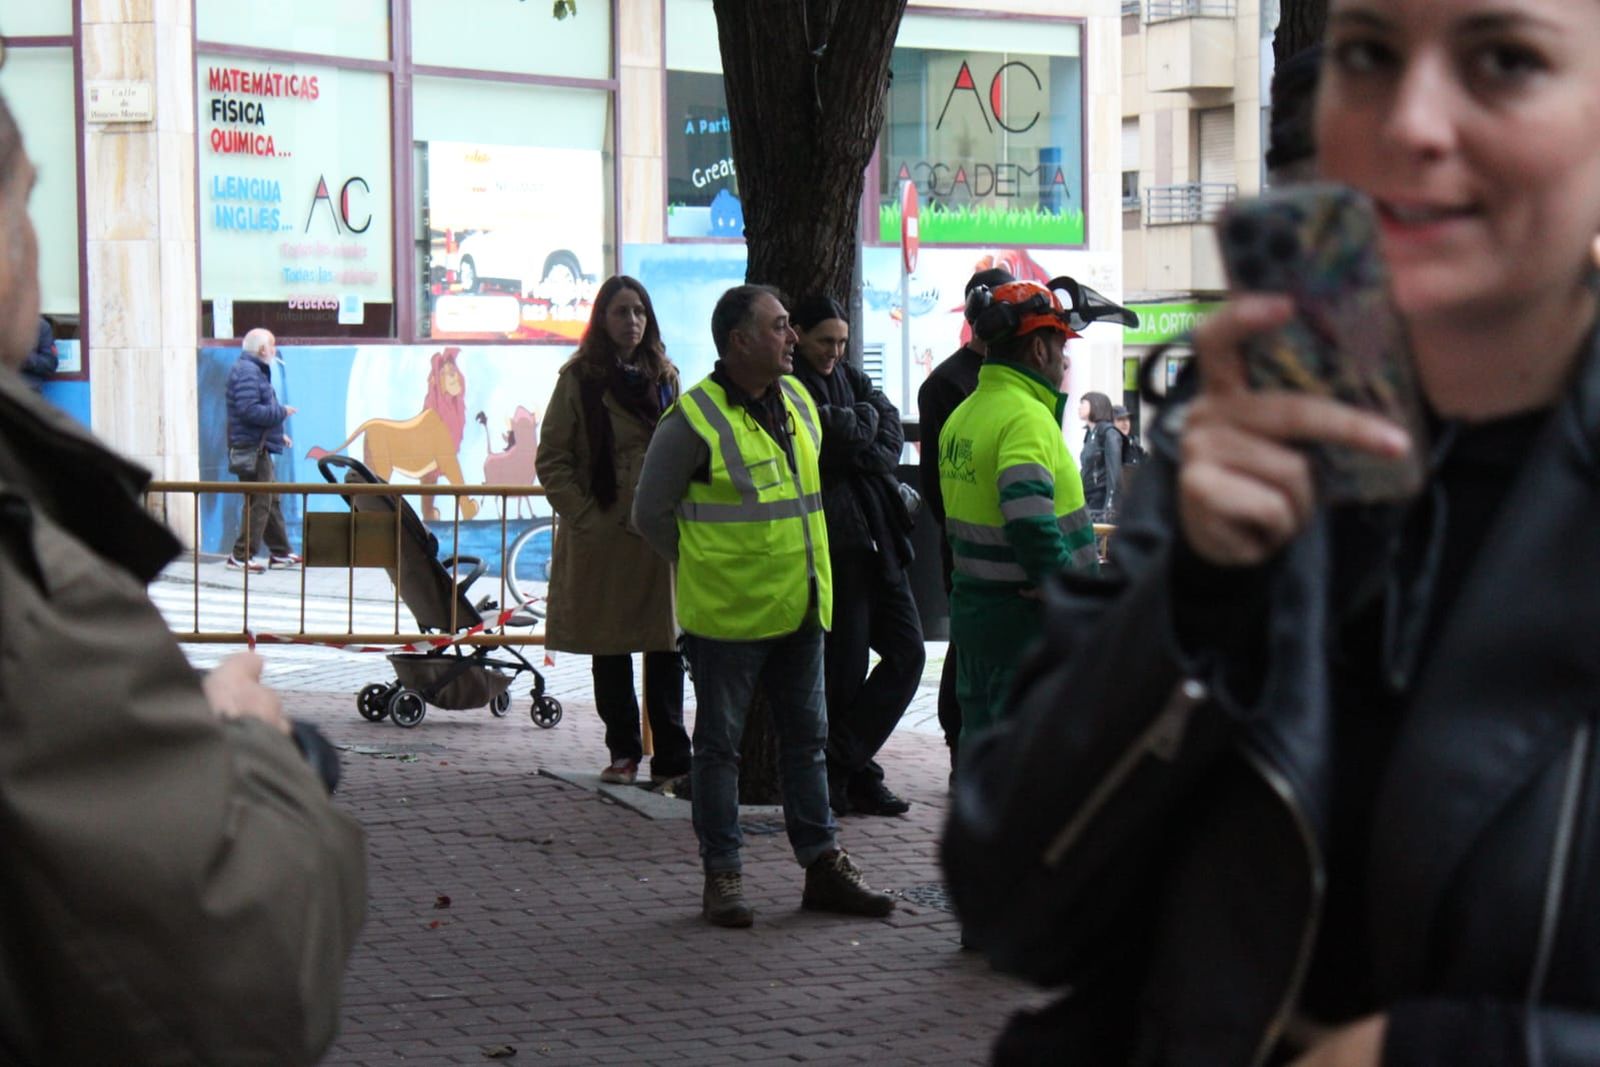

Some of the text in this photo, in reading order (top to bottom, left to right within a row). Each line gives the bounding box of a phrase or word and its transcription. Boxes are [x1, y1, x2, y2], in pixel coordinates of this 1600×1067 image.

[209, 66, 320, 100] MATEMÁTICAS
[937, 60, 1042, 133] AC
[211, 94, 265, 126] FÍSICA
[685, 120, 695, 135] A
[213, 175, 282, 202] LENGUA
[305, 173, 372, 234] AC
